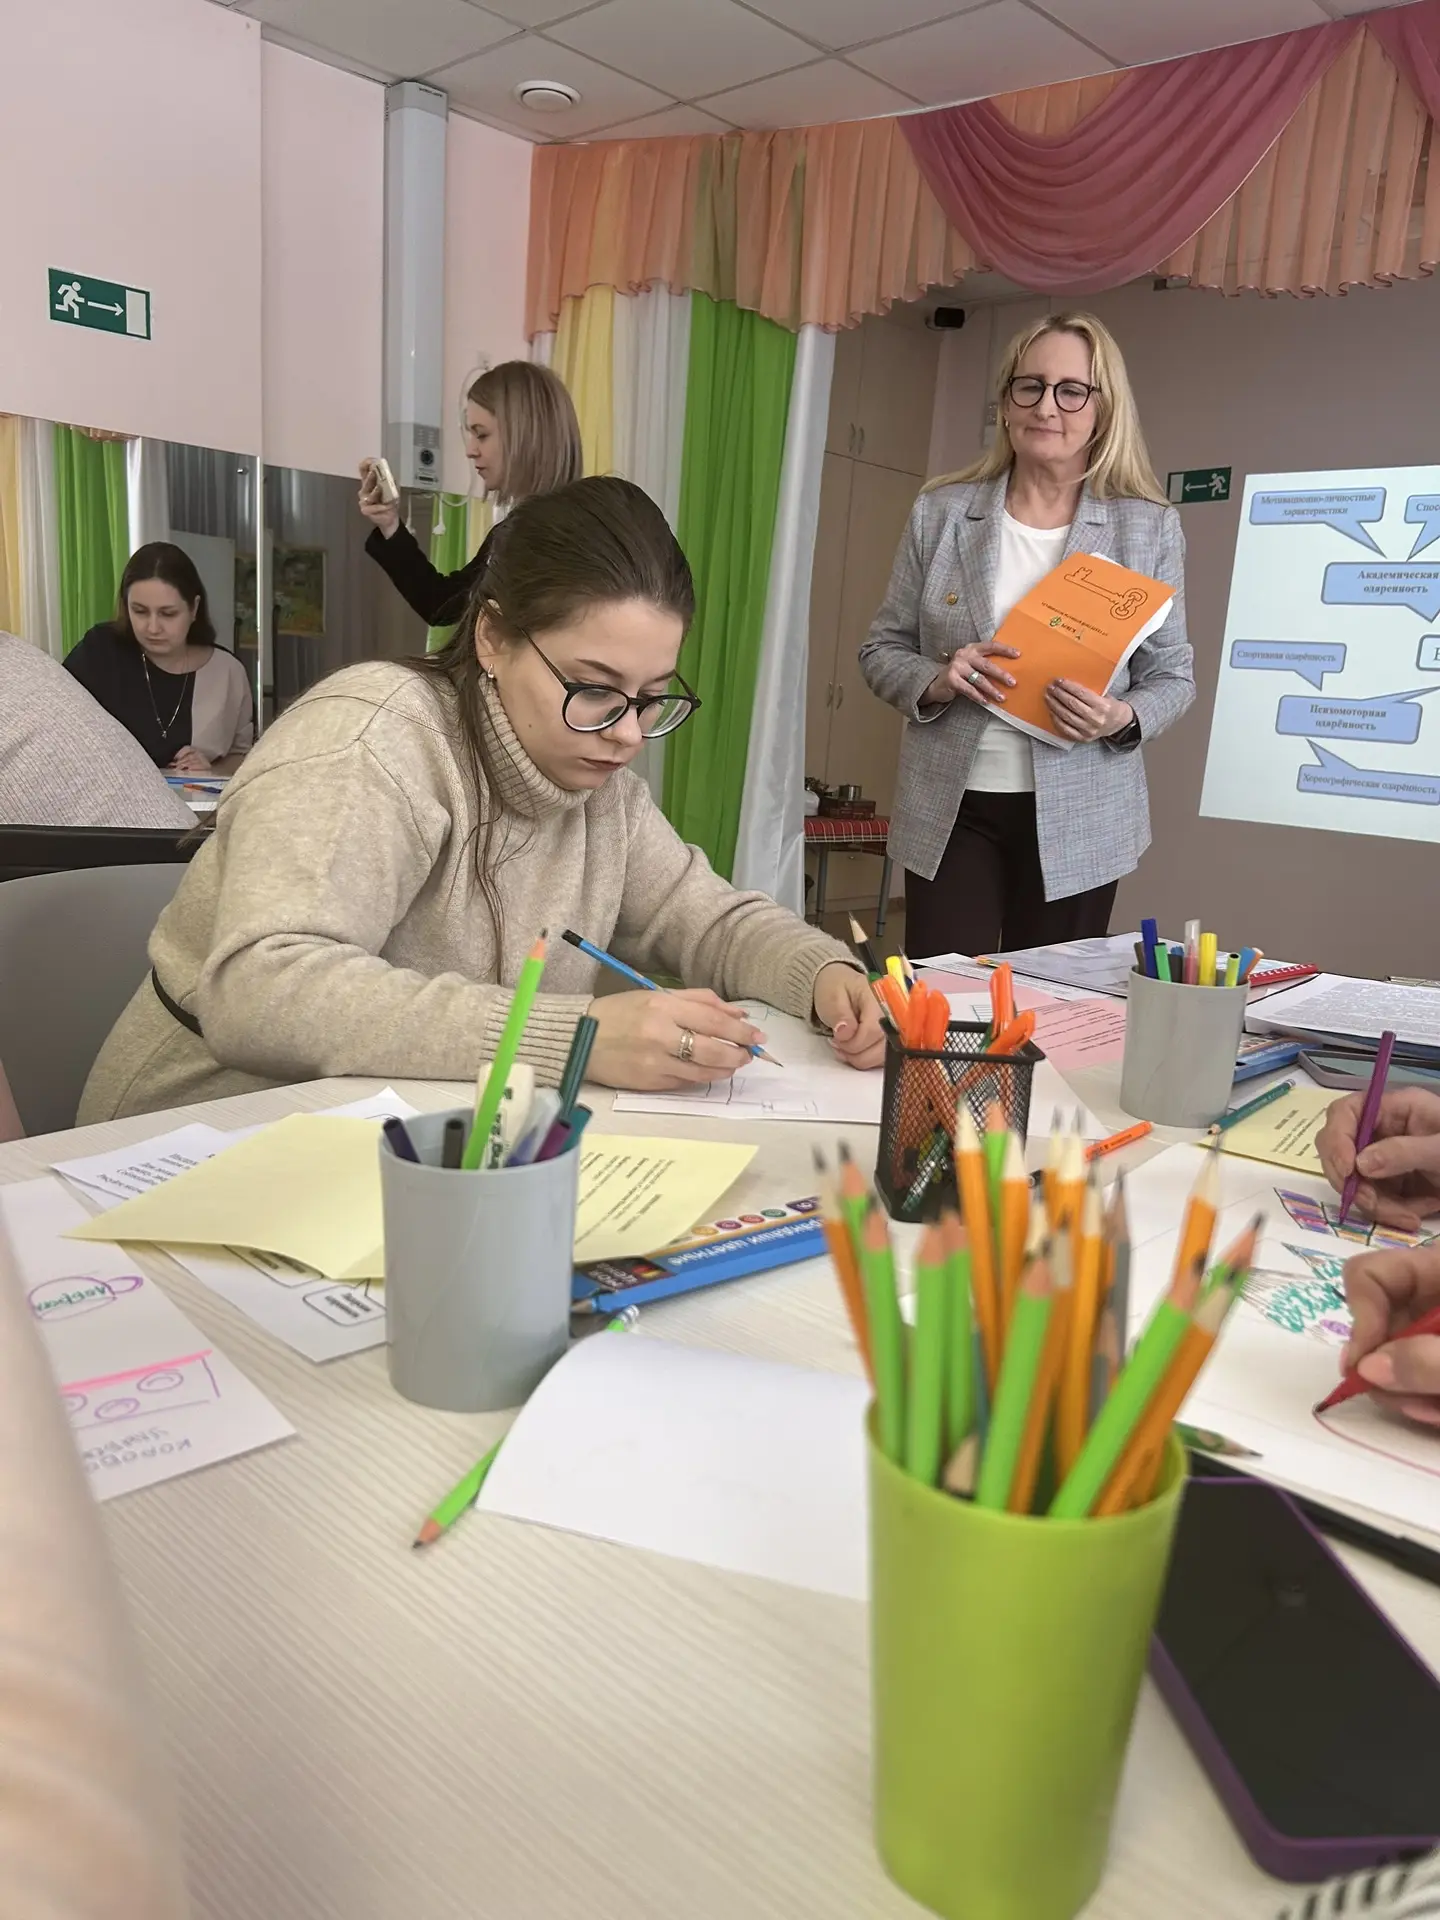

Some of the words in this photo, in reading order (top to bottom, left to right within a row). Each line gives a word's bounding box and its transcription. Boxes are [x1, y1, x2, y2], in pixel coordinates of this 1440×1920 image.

[1261, 493, 1376, 506] Мотивационно-личностные
[1282, 506, 1349, 517] характеристики
[1357, 570, 1440, 582] Академическая
[1237, 650, 1284, 662] Спортивная
[1310, 703, 1387, 719] Психомоторная
[1303, 772, 1380, 790] Хореографическая
